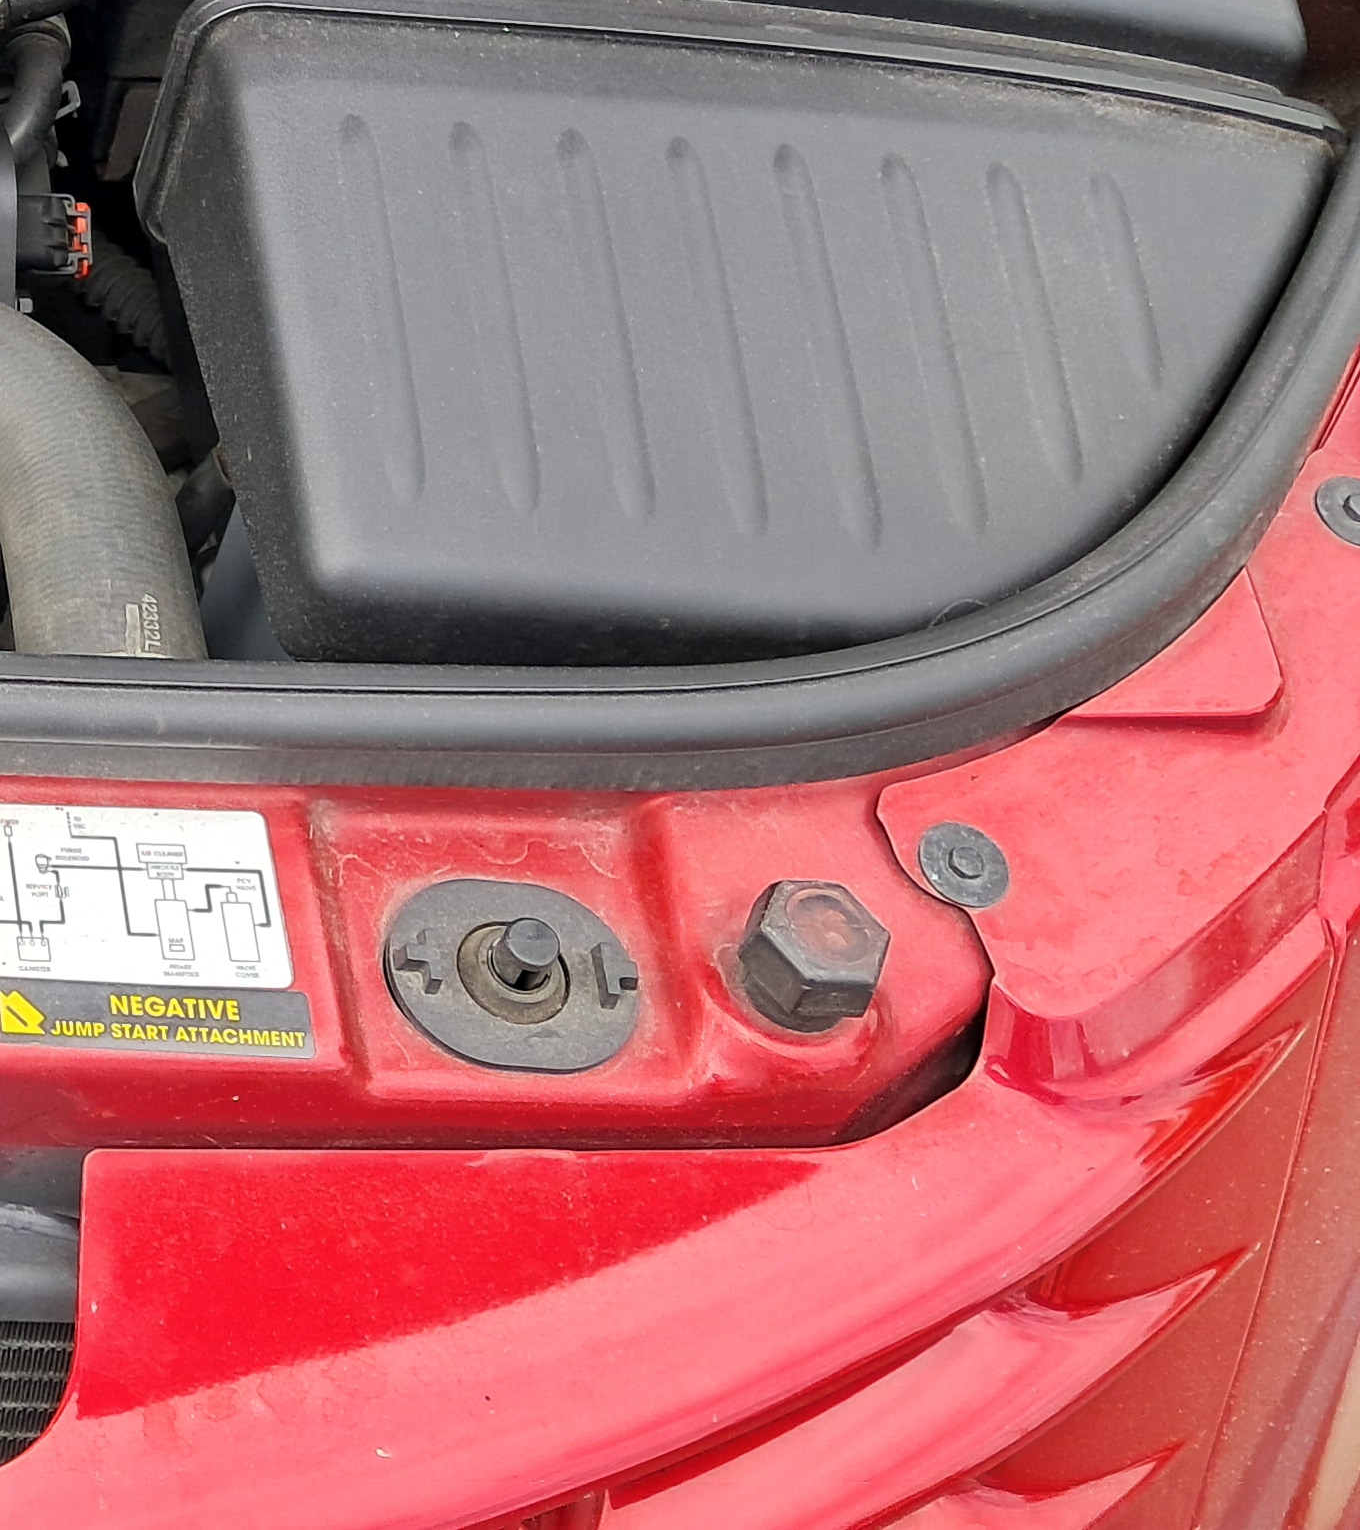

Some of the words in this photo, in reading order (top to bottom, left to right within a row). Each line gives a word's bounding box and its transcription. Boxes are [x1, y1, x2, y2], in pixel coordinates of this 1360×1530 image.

[109, 993, 241, 1022] NEGATIVE
[50, 1020, 106, 1038] JUMP
[111, 1022, 169, 1042] START
[174, 1026, 306, 1049] ATTACHMENT
